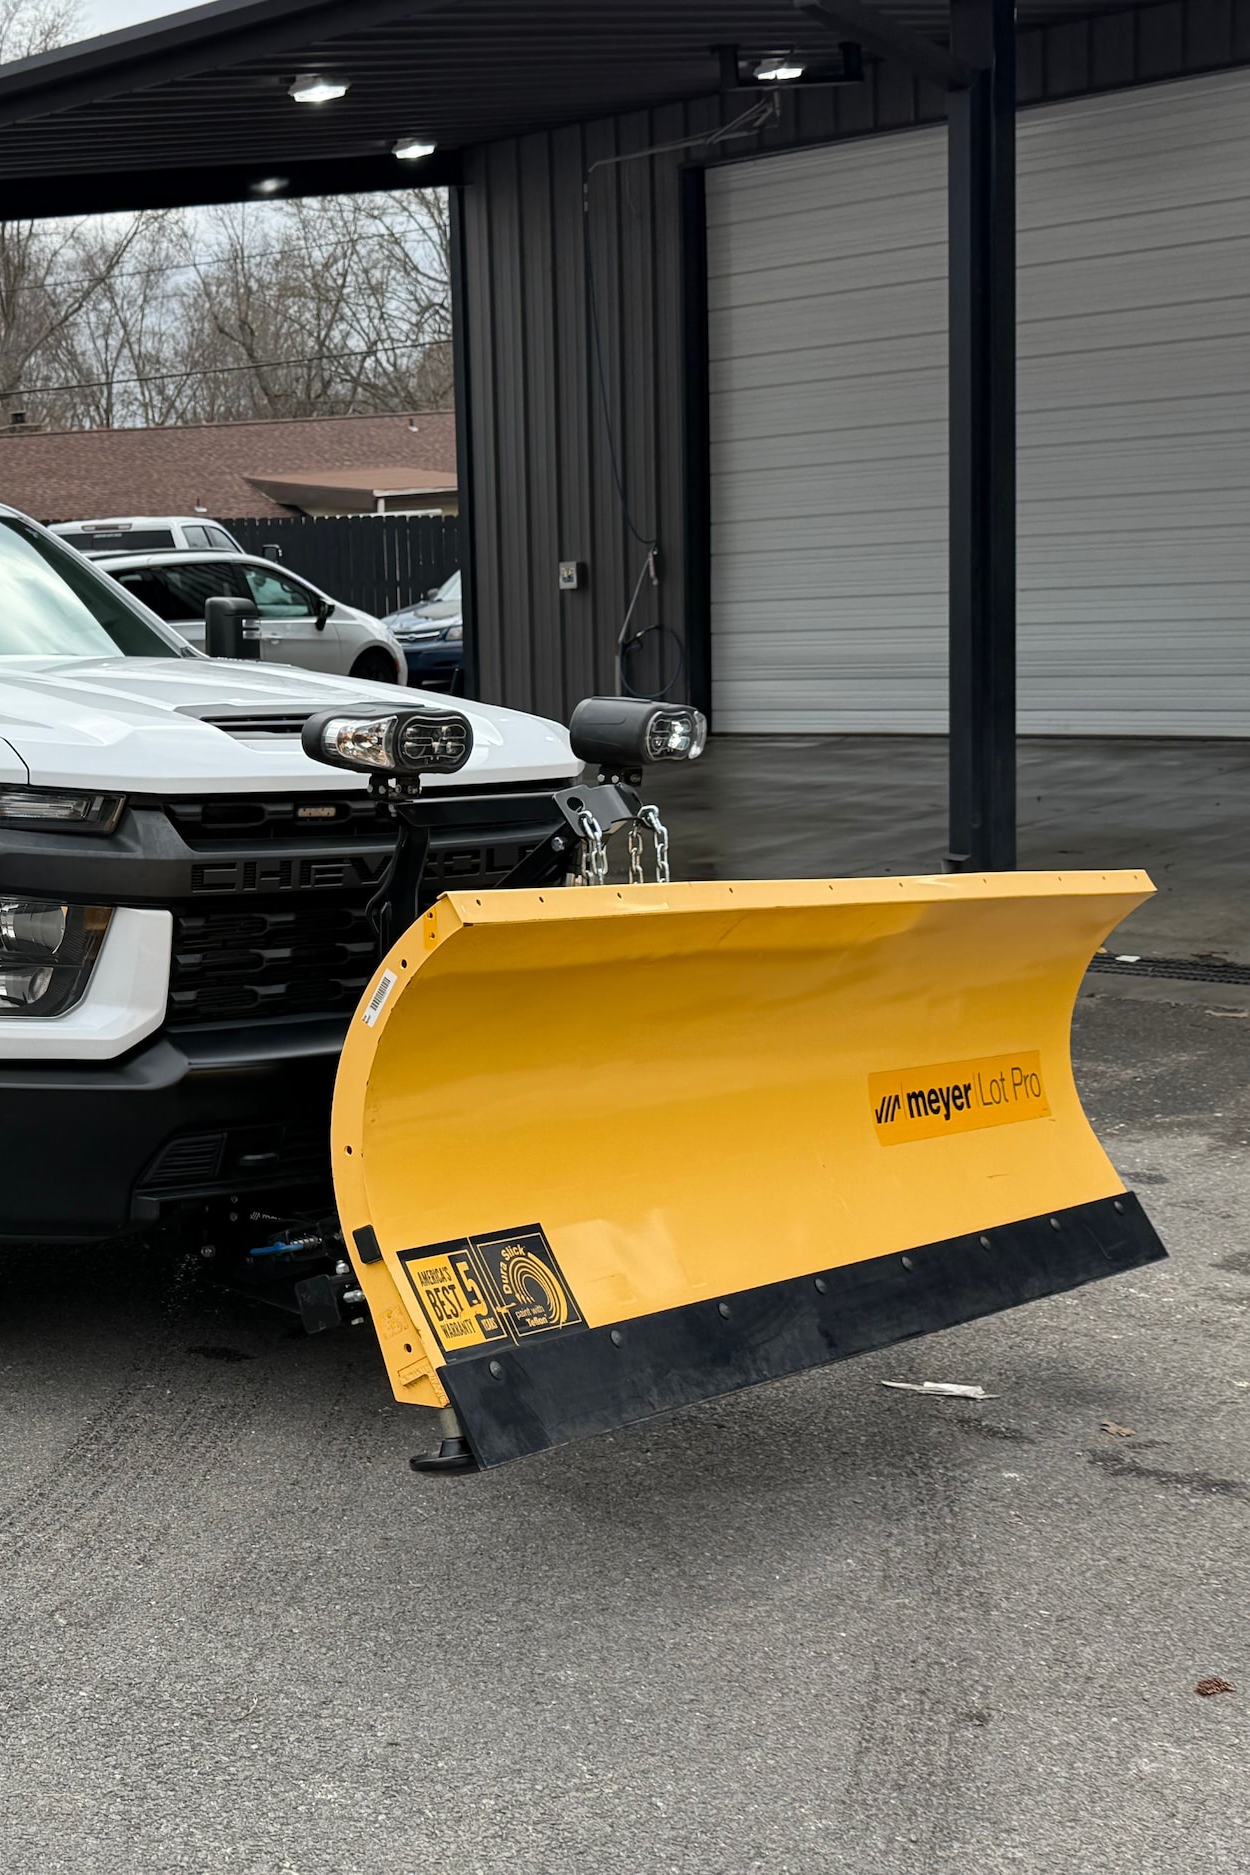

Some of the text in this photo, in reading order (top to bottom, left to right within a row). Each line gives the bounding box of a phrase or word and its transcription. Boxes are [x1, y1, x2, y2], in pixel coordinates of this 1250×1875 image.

[907, 1066, 1042, 1121] meyer Lot Pro
[501, 1244, 526, 1261] Slick
[425, 1284, 464, 1321] BEST
[440, 1318, 476, 1339] WARRANTY
